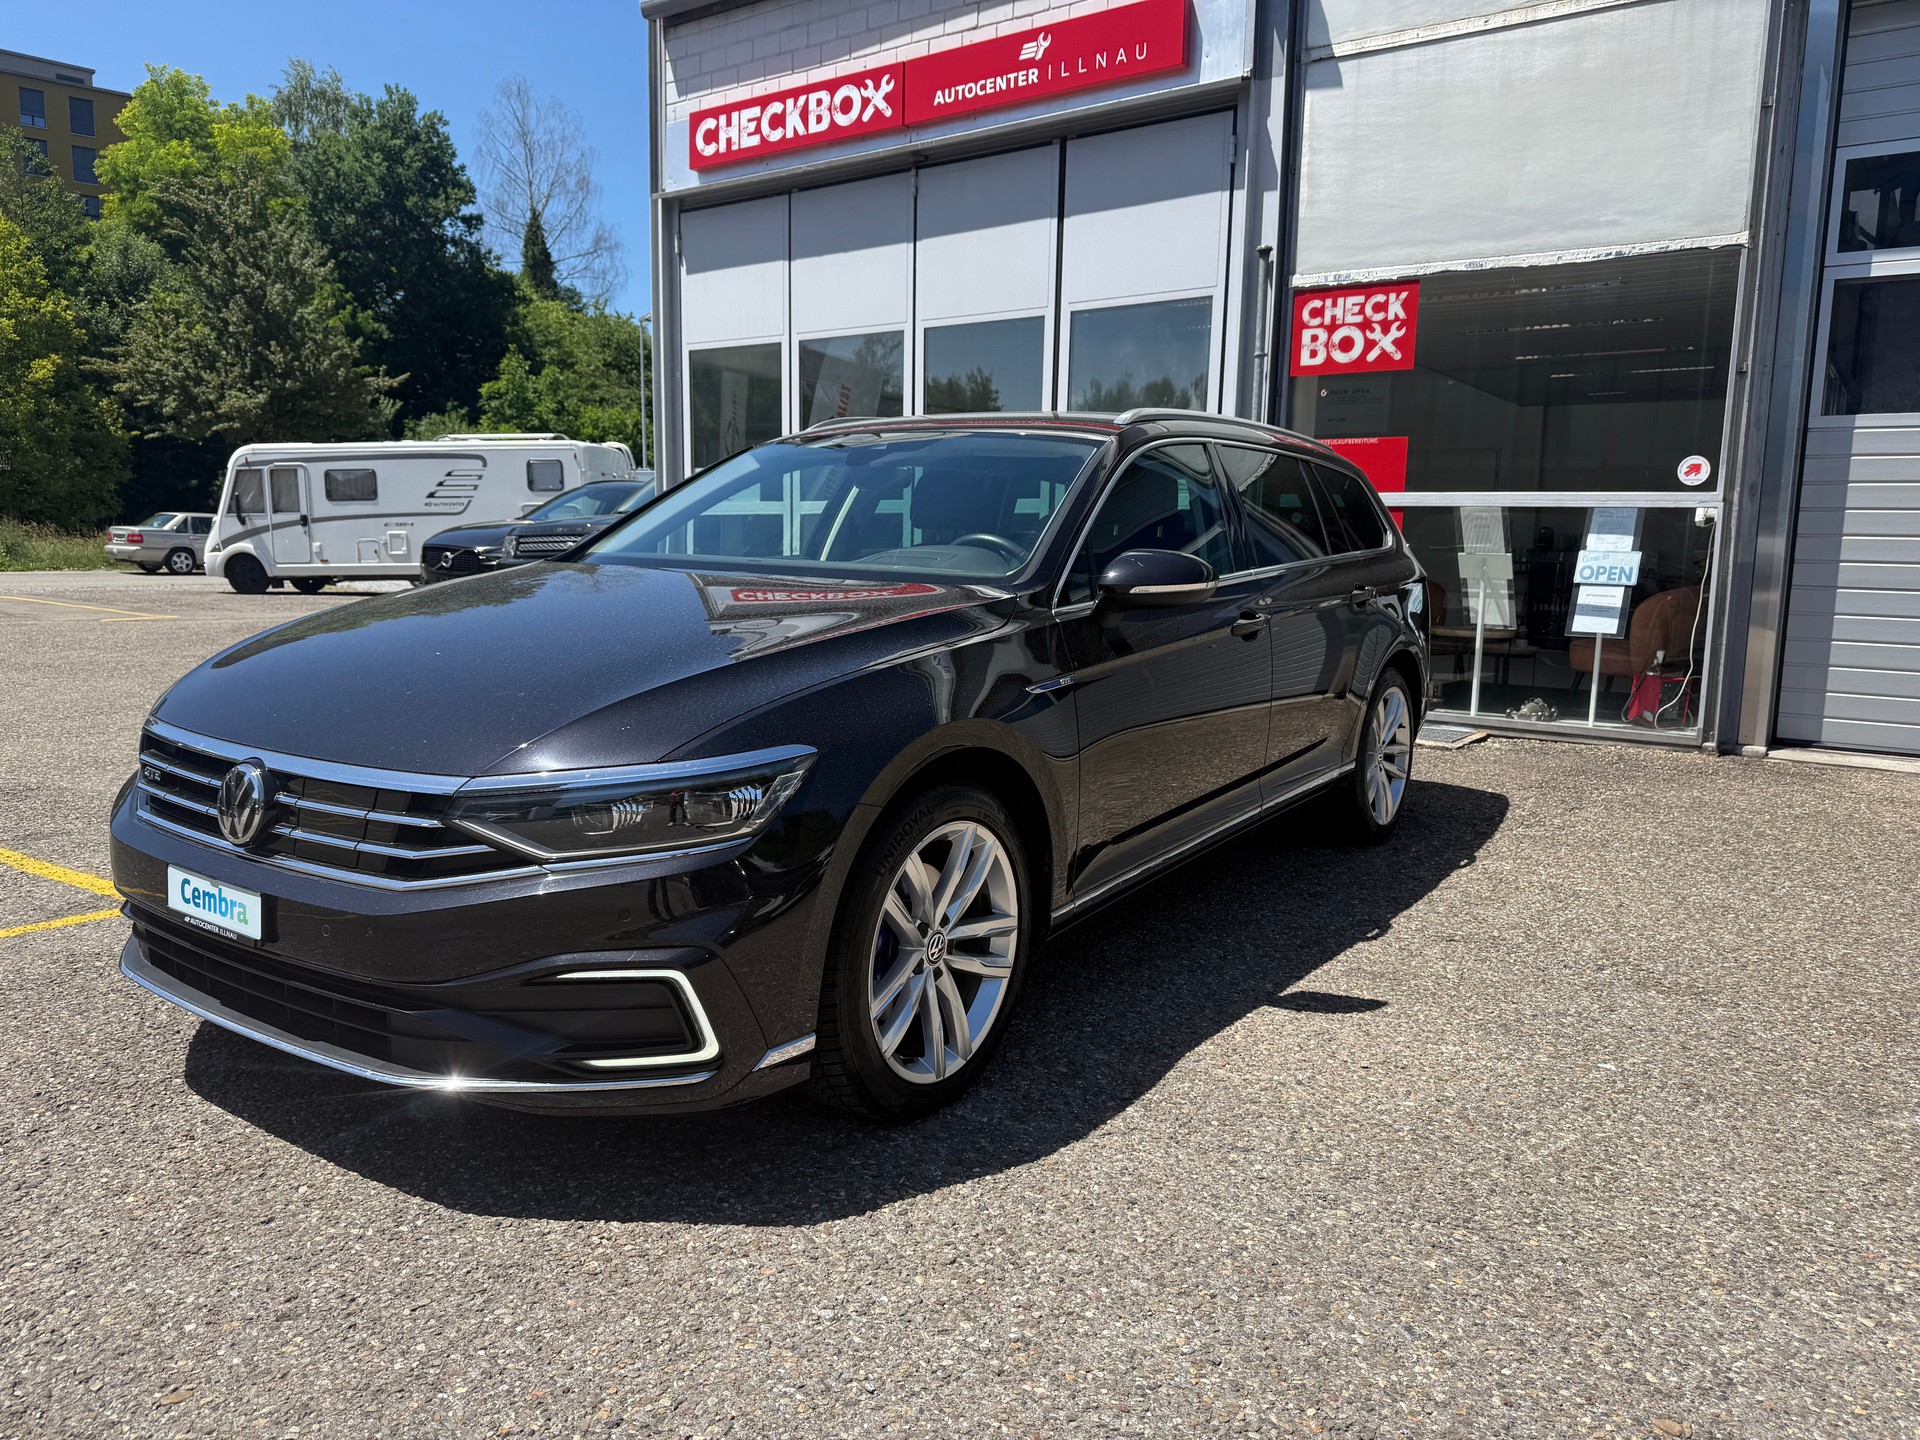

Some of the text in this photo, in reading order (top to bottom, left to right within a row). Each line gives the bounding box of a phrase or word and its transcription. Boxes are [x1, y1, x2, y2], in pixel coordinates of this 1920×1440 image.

[933, 42, 1148, 106] AUTOCENTER ILLNAU
[695, 74, 895, 157] CHECKBOX
[1302, 290, 1409, 326] CHECK
[1300, 321, 1406, 366] BOX
[1579, 565, 1634, 583] OPEN
[875, 804, 935, 877] UNIROYAL
[181, 877, 249, 926] Cembra
[190, 917, 219, 934] AUTOCENTER
